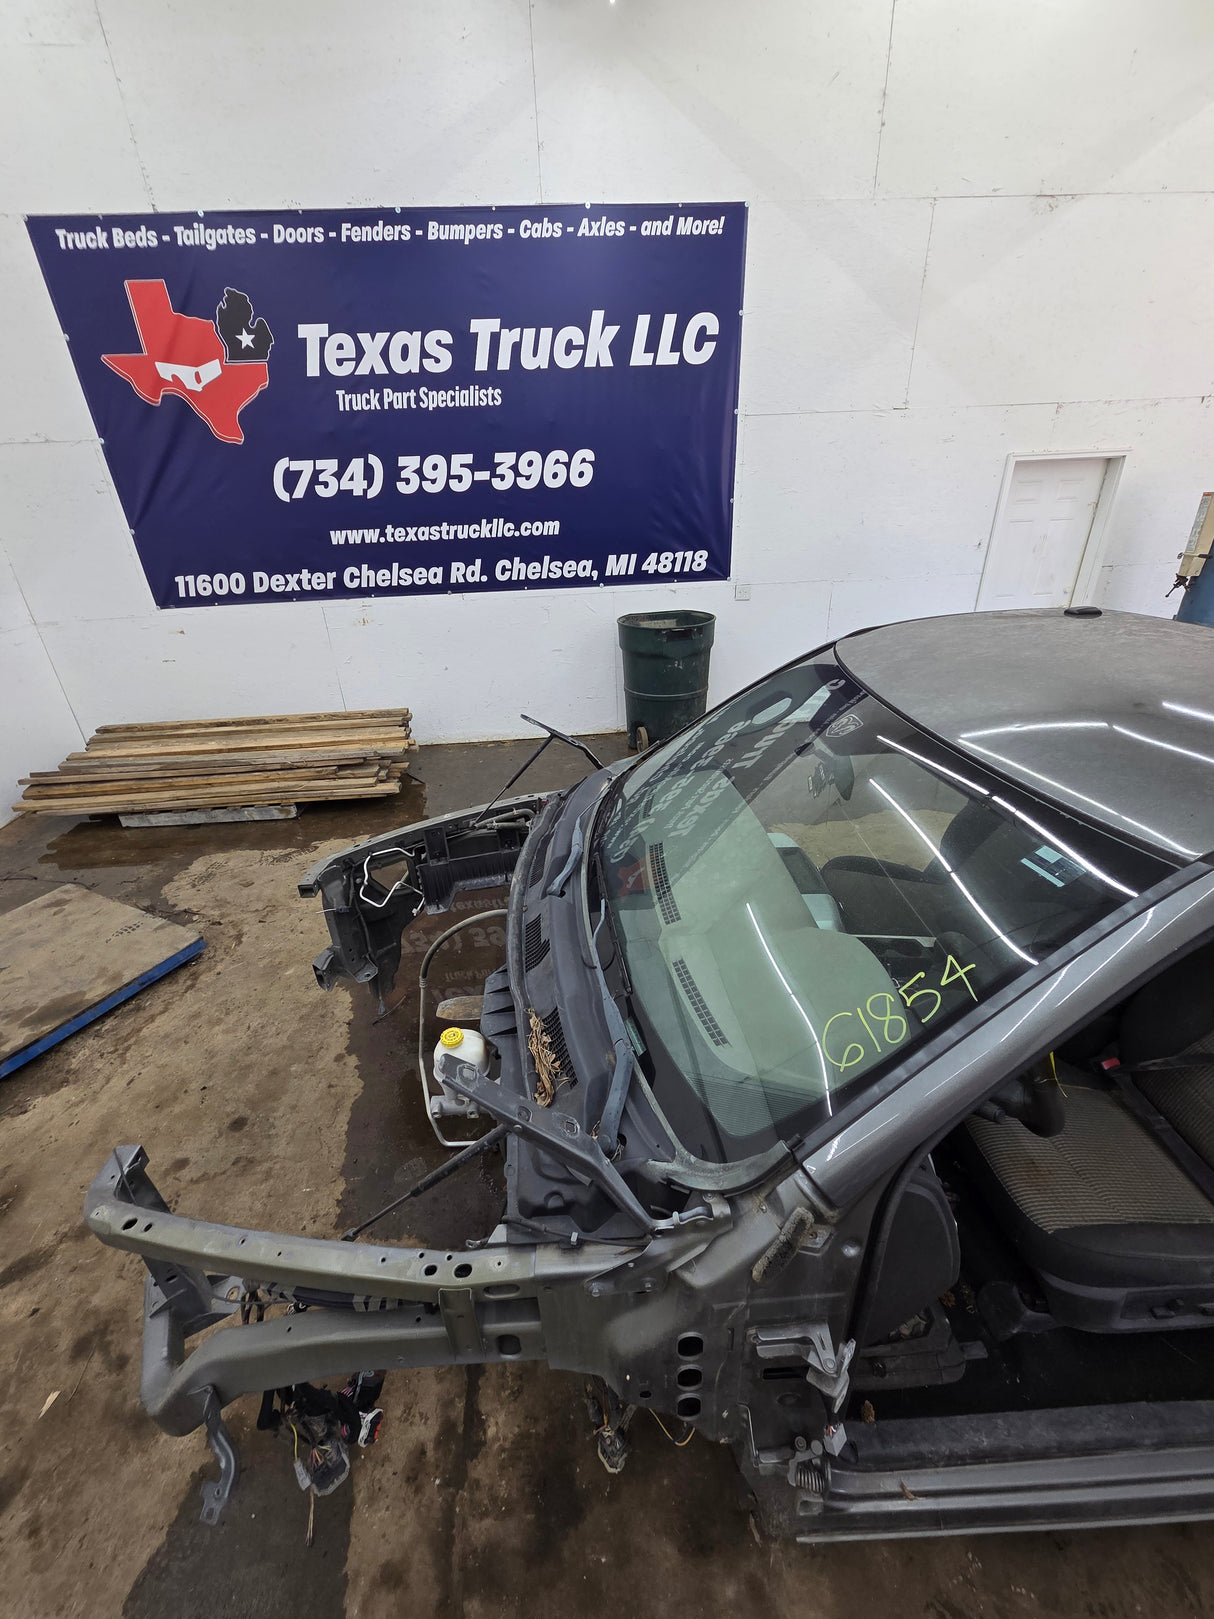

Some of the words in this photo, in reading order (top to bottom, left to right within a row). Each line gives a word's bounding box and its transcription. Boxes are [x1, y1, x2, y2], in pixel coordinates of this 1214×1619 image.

[55, 226, 109, 250] Truck
[111, 225, 158, 248] Beds
[174, 223, 256, 251] Tailgates
[273, 224, 325, 244] Doors
[341, 221, 411, 242] Fenders
[428, 221, 503, 245] Bumpers
[519, 217, 562, 239] Cabs
[577, 216, 625, 237] Axles
[641, 215, 674, 236] and
[676, 215, 725, 236] More!
[298, 324, 453, 377] Texas
[470, 310, 620, 371] Truck
[629, 312, 719, 367] LLC
[336, 389, 382, 411] Truck
[383, 388, 417, 409] Part
[418, 385, 502, 410] Specialists
[273, 454, 384, 503] (734)
[396, 449, 596, 495] 395-3966
[330, 518, 560, 545] www.texastruckllc.com
[175, 573, 246, 598] 11600
[253, 569, 337, 594] Dexter
[344, 563, 443, 589] Chelsea
[450, 559, 488, 584] Rd.
[495, 556, 598, 582] Chelsea,
[605, 554, 637, 577] MI
[642, 550, 709, 574] 48118
[822, 954, 979, 1073] 61854
